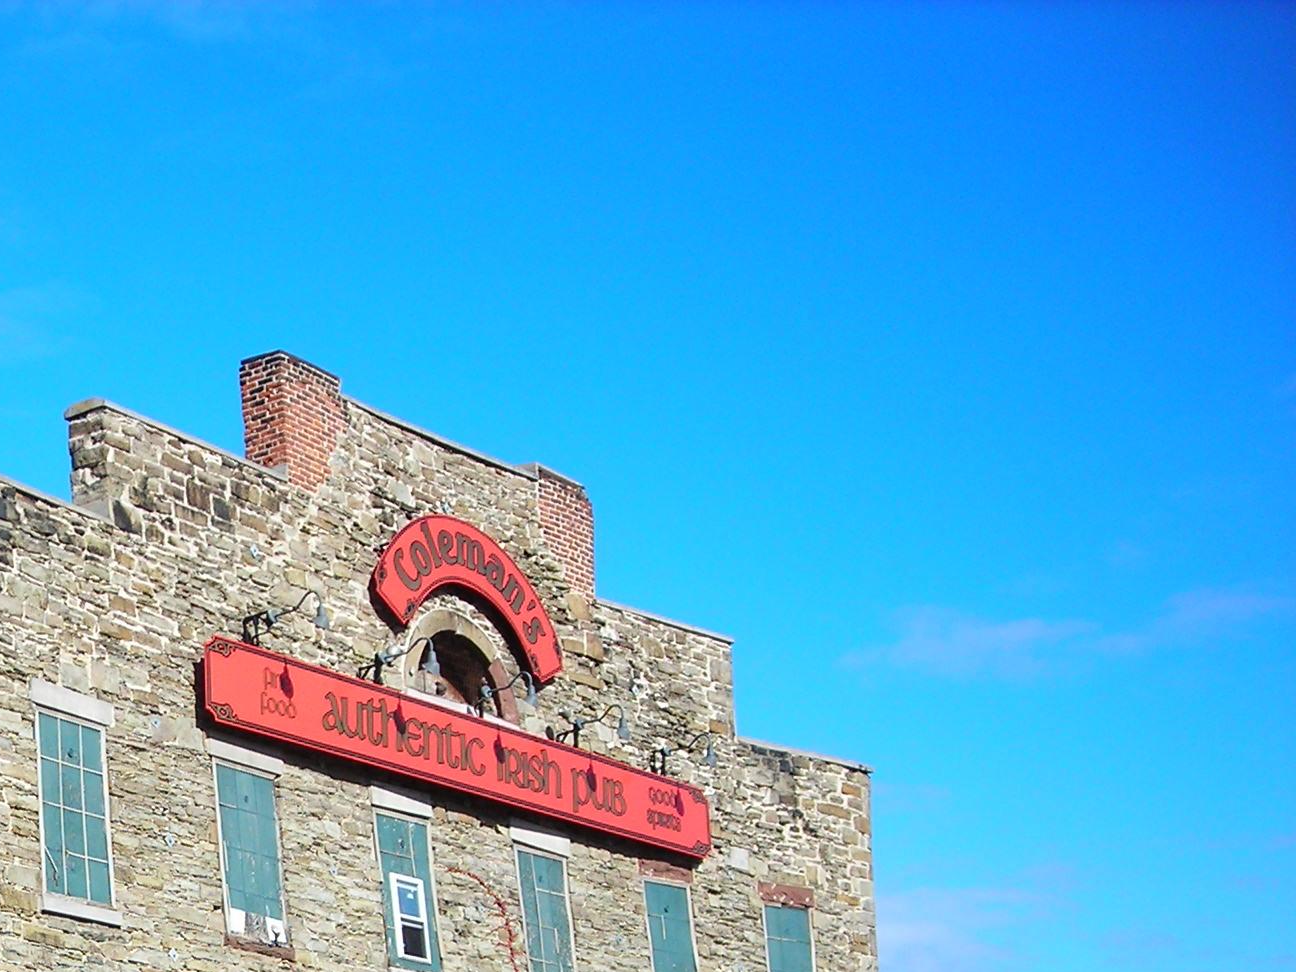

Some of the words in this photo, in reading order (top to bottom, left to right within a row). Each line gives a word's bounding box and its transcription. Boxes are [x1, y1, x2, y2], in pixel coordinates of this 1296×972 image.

[393, 520, 546, 645] Coleman's
[260, 691, 297, 719] food
[321, 691, 486, 777] authentic
